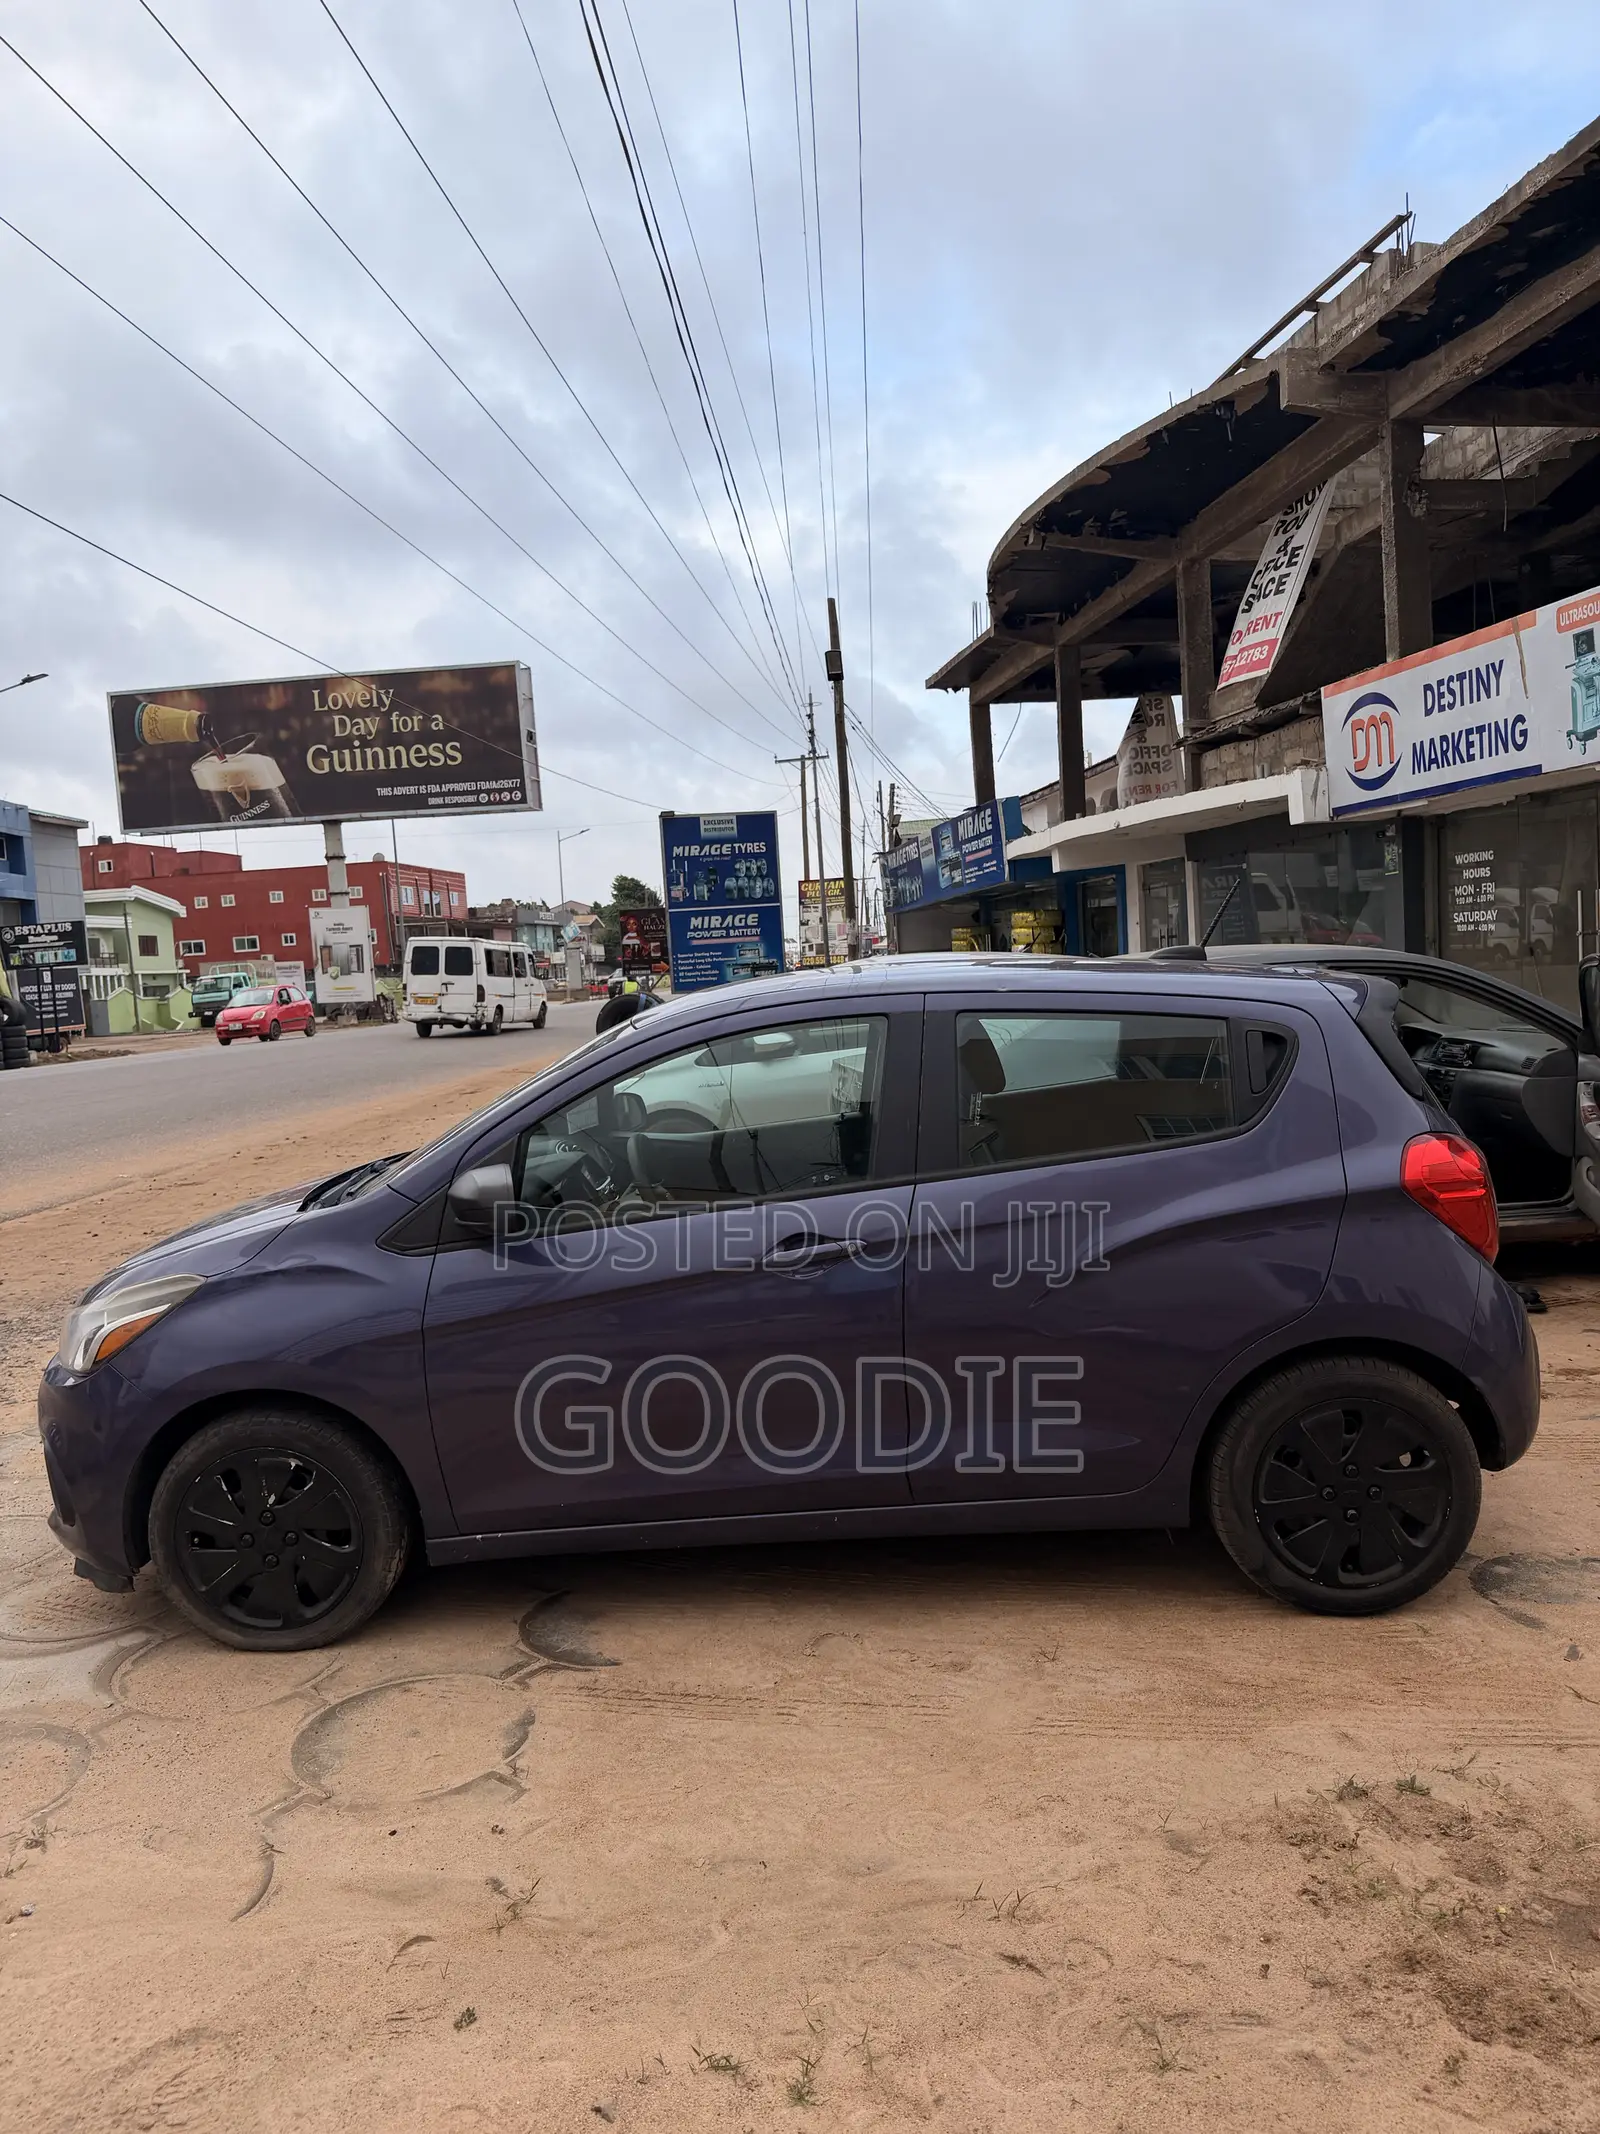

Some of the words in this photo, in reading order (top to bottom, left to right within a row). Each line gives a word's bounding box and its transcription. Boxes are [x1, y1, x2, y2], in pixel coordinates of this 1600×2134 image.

[1276, 535, 1295, 556] &
[1244, 611, 1283, 637] RENT
[1423, 659, 1504, 717] DESTINY
[312, 685, 394, 712] Lovely
[332, 715, 380, 739] Day
[390, 712, 422, 733] for
[431, 714, 444, 730] a
[1412, 714, 1528, 775] MARKETING
[306, 740, 462, 774] Guinness
[376, 788, 392, 796] THIS
[393, 786, 418, 796] ADVERT
[428, 785, 440, 794] FDA
[442, 782, 476, 792] APPROVED
[428, 796, 444, 805] DRINK
[230, 800, 270, 822] GUINNESS
[958, 808, 992, 842] MIRAGE
[672, 844, 732, 858] MIRAGE
[733, 842, 766, 854] TYRES
[1454, 850, 1494, 864] WORKING
[1462, 867, 1490, 880] HOURS
[1454, 884, 1474, 896] MON
[1482, 882, 1495, 894] FRI
[690, 913, 758, 930] MIRAGE
[1454, 910, 1498, 923] SATURDAY
[14, 922, 72, 936] ESTAPLUS
[686, 930, 727, 938] POWER
[729, 928, 761, 936] BATTERY
[1488, 924, 1496, 932] PM
